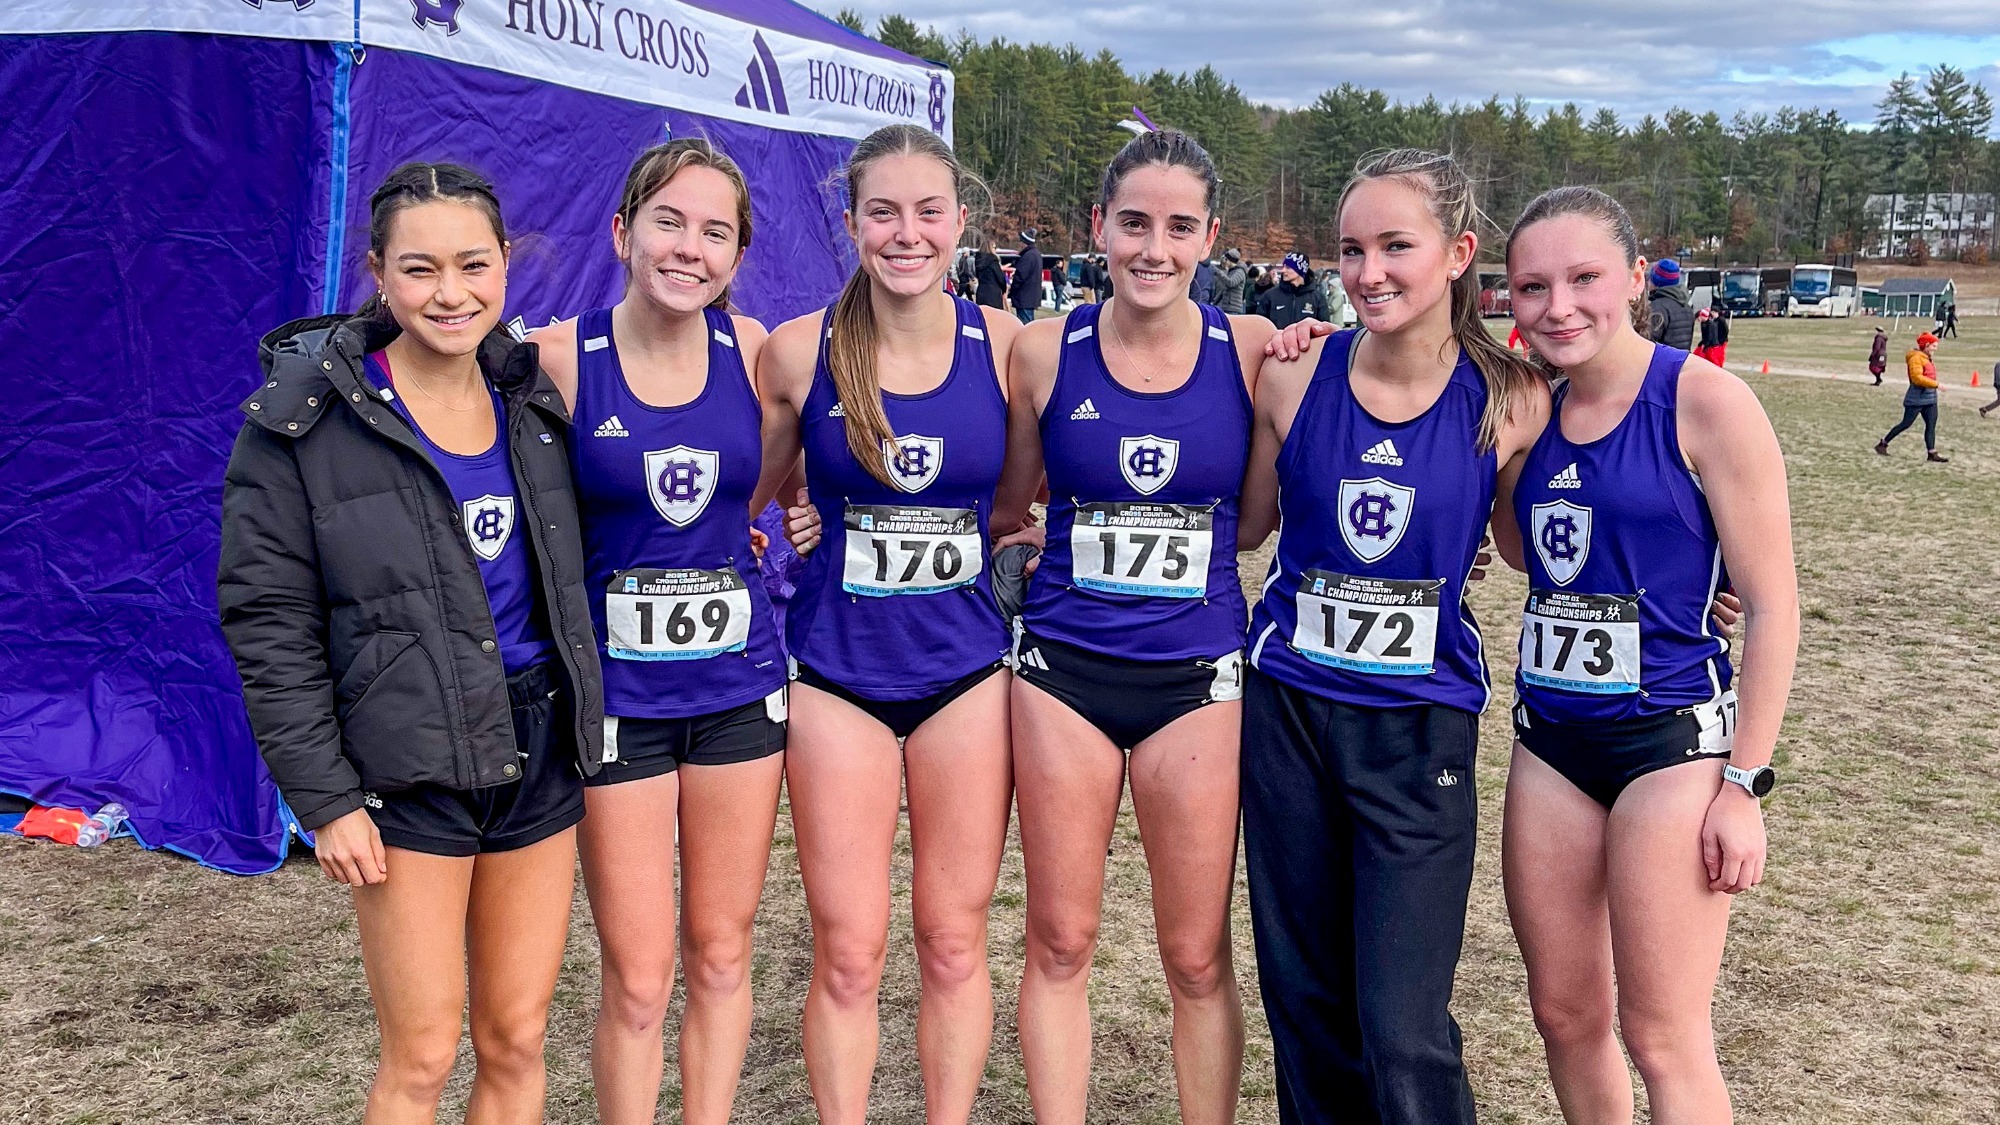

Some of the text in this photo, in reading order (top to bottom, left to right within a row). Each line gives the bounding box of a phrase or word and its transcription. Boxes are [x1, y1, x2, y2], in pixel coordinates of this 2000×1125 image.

[505, 0, 604, 51] HOLY
[614, 8, 709, 77] CROSS
[807, 58, 915, 118] HOLY CROSS
[1070, 411, 1100, 420] adidas
[594, 428, 629, 438] adidas
[1361, 453, 1404, 467] adidas
[1548, 479, 1582, 489] adidas
[877, 521, 953, 533] CHAMPIONSHIPS
[1108, 516, 1185, 528] CHAMPIONSHIPS
[872, 538, 962, 583] 170
[1099, 532, 1189, 580] 175
[642, 581, 720, 594] CHAMPIONSHIPS
[1327, 587, 1406, 604] CHAMPIONSHIPS
[1362, 586, 1393, 594] COUNTRY
[1538, 604, 1602, 620] CHAMPIONSHIPS
[635, 599, 730, 645] 169
[1321, 603, 1414, 657] 172
[1533, 622, 1614, 676] 173
[1437, 769, 1458, 786] alo
